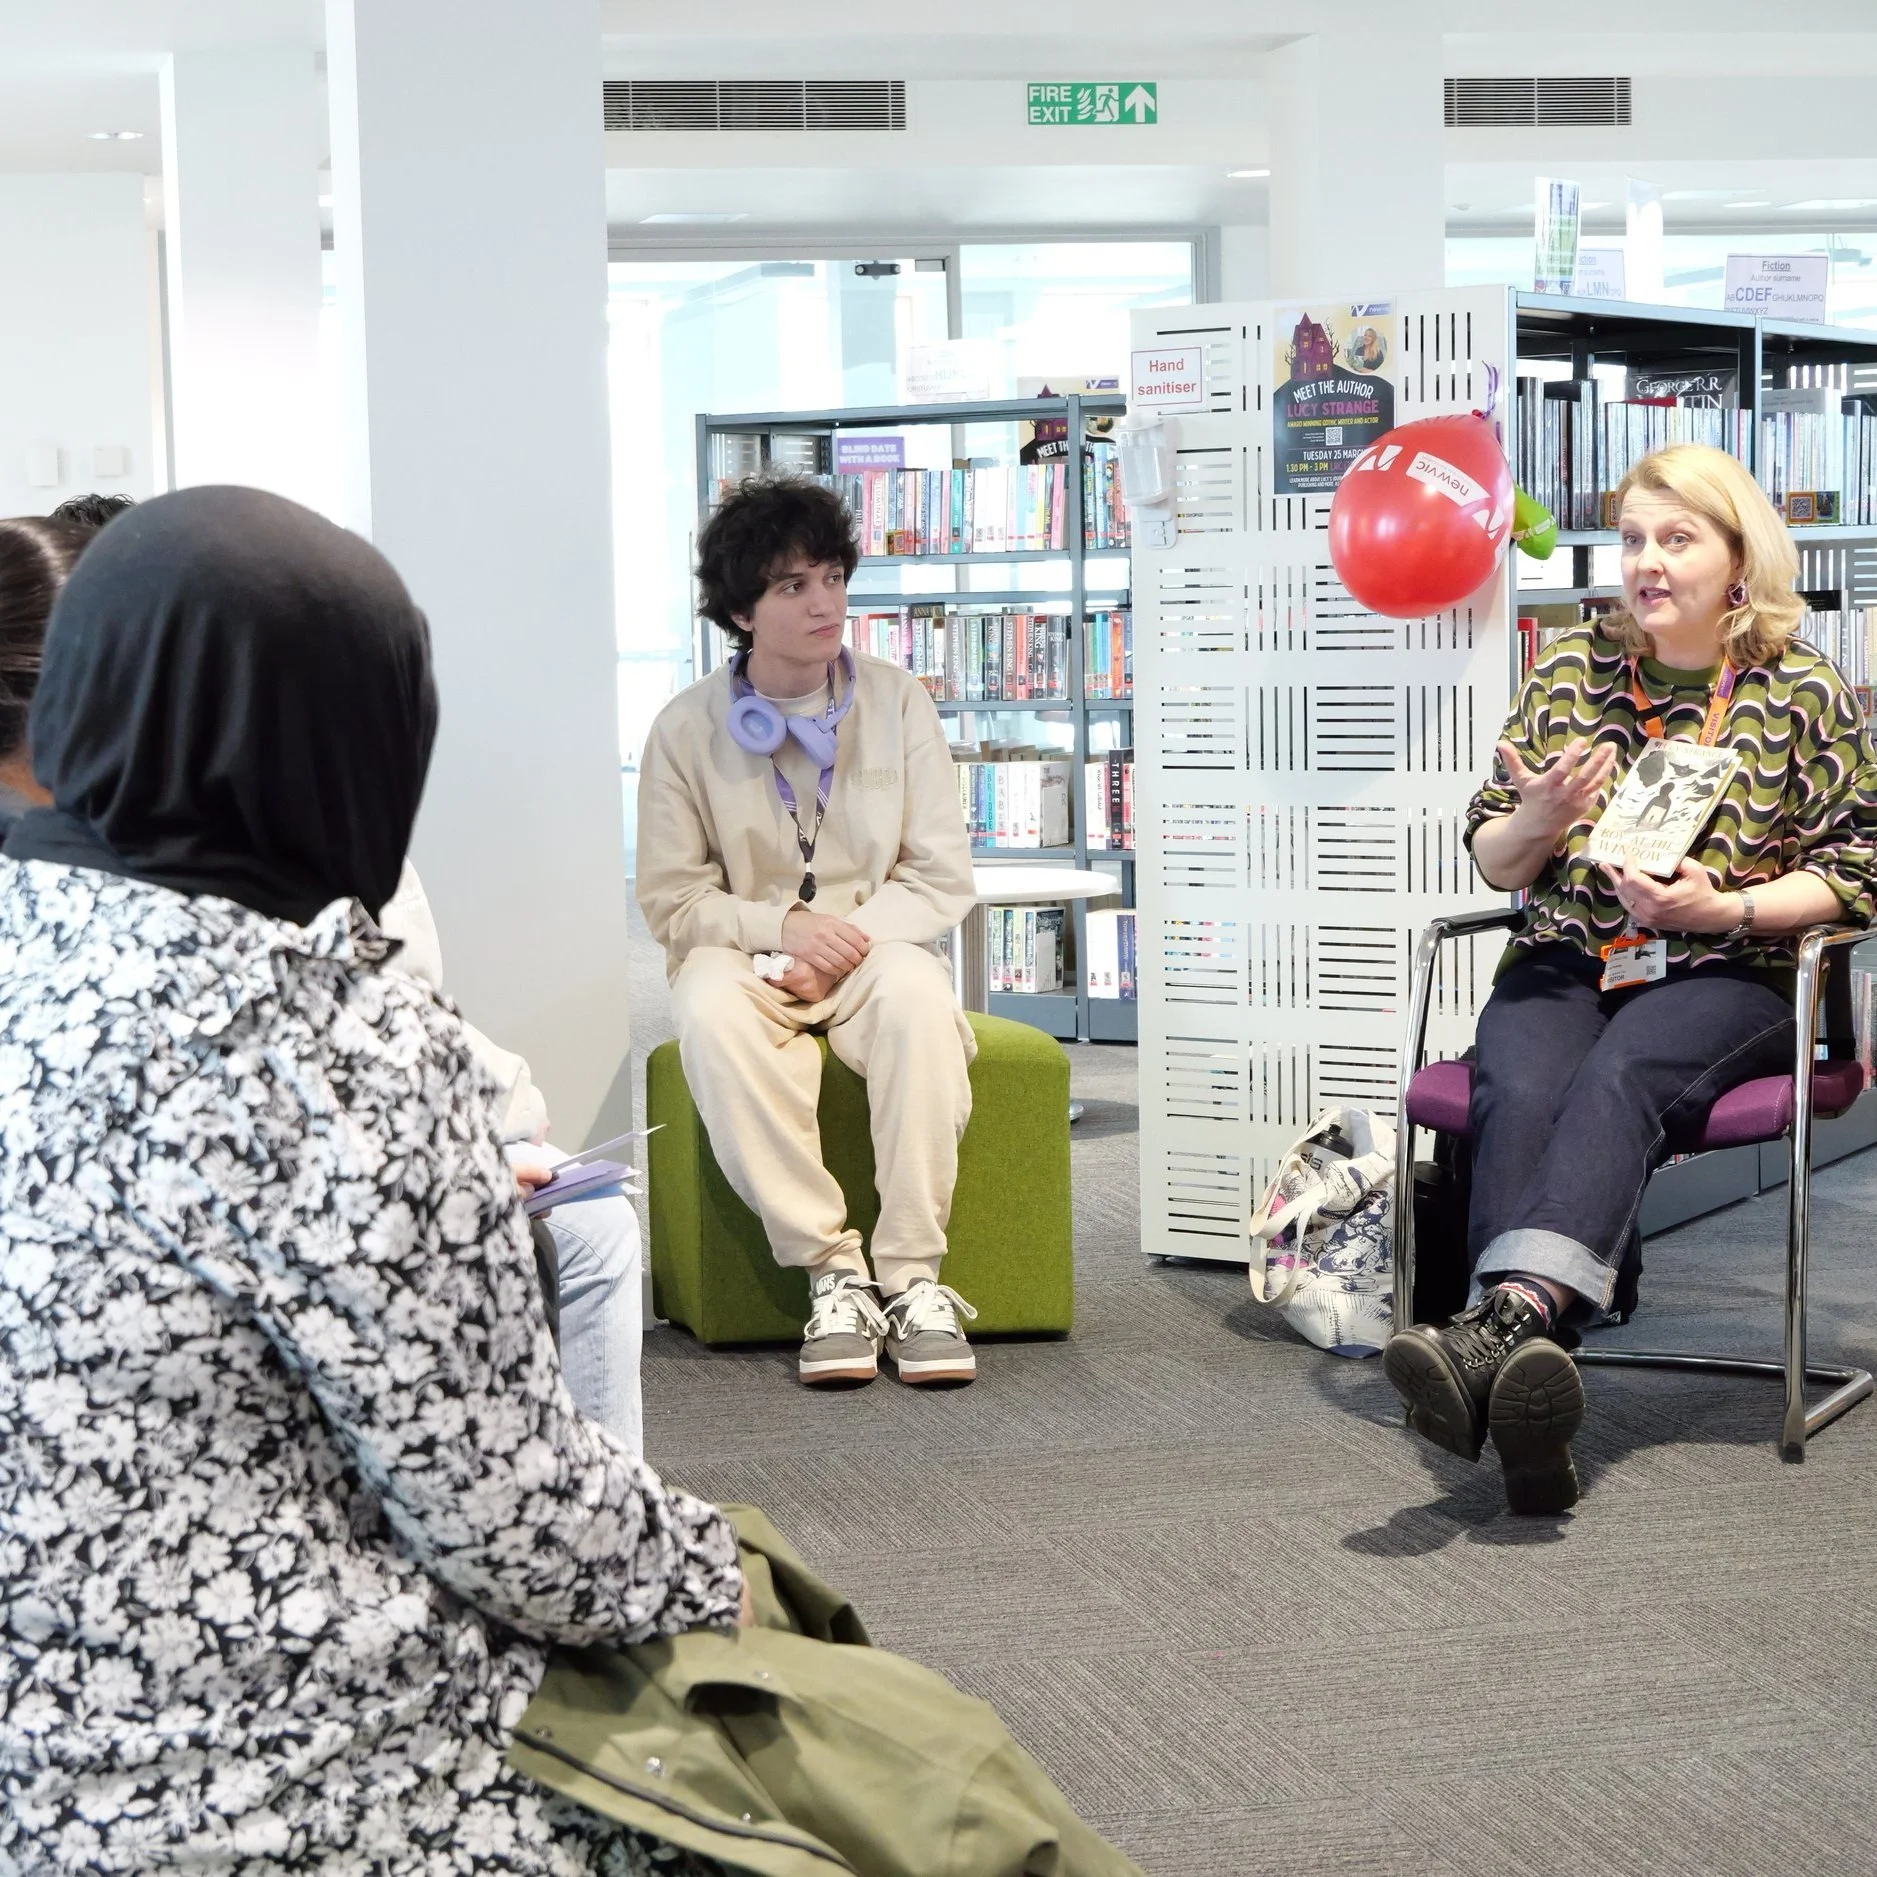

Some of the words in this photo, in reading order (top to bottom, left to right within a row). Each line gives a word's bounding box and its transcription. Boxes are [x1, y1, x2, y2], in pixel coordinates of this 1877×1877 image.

[1029, 86, 1072, 102] FIRE
[1029, 106, 1072, 122] EXIT
[1762, 260, 1791, 271] Fiction
[1149, 358, 1184, 372] Hand
[1137, 381, 1196, 396] sanitiser
[1293, 383, 1316, 404] MEET
[1318, 380, 1335, 394] THE
[1336, 380, 1374, 400] AUTHOR
[1287, 403, 1318, 418] LUCY
[1322, 400, 1379, 416] STRANGE
[841, 444, 869, 454] BLIND
[871, 444, 896, 453] DATE
[1037, 442, 1058, 458] MEET
[1058, 440, 1069, 452] TH
[1303, 450, 1333, 460] TUESDAY
[1334, 450, 1342, 459] 25
[1343, 449, 1365, 458] MARC
[839, 455, 864, 464] WITH
[873, 455, 900, 463] BOOK
[1286, 464, 1298, 473] 1.30
[1299, 463, 1309, 472] PM
[1320, 462, 1329, 471] PM
[1416, 460, 1470, 497] newvic
[915, 624, 923, 659] STEPHEN
[1111, 762, 1120, 804] THREE
[1600, 828, 1625, 840] BOY
[1630, 836, 1646, 845] AT
[1651, 839, 1674, 851] THE
[1598, 840, 1662, 862] WINDOW
[815, 1274, 836, 1295] VANS
